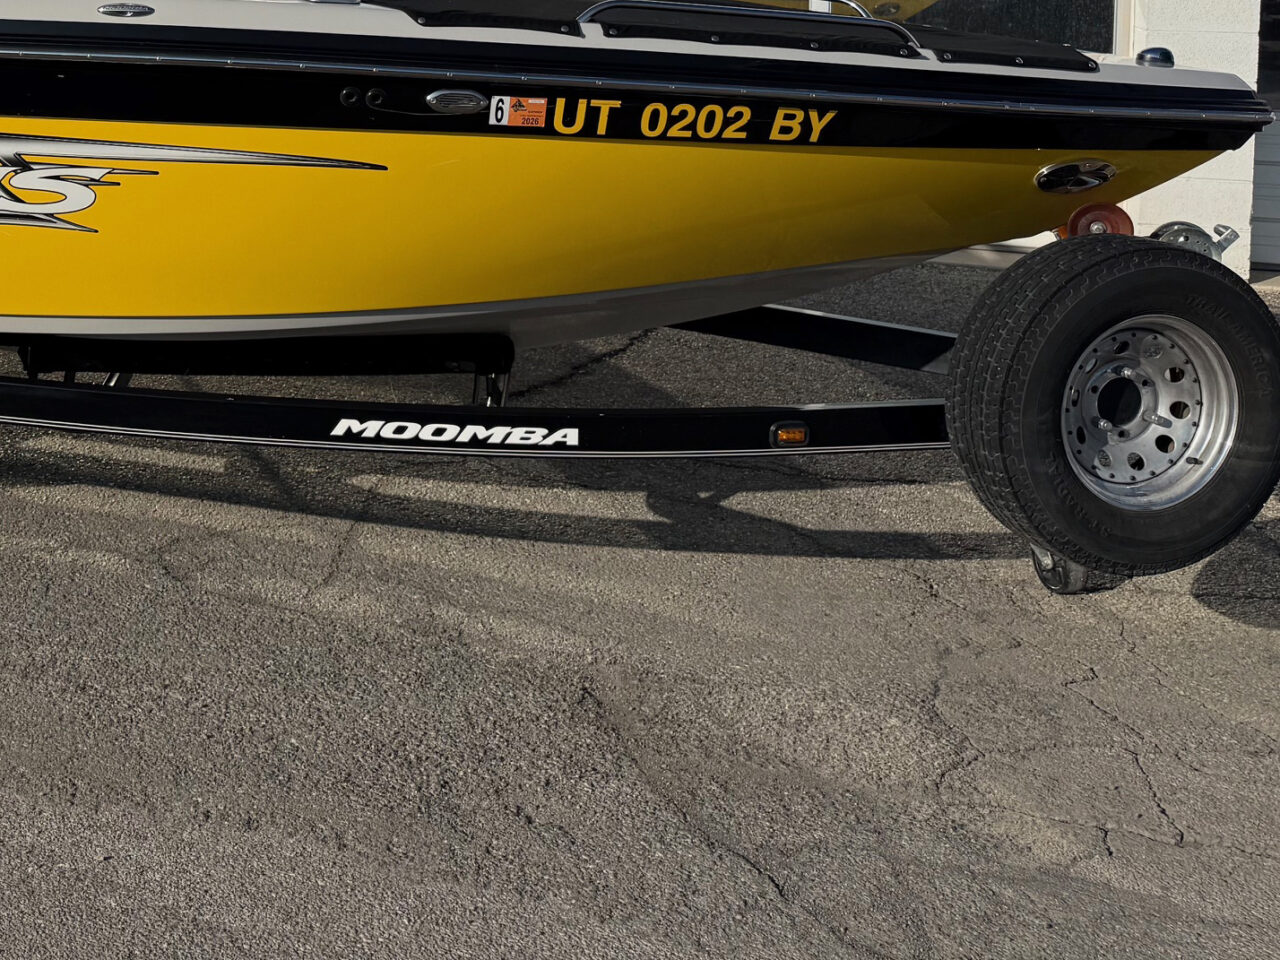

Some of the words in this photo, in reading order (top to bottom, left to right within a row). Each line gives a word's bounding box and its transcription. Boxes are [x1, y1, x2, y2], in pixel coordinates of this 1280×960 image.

[495, 98, 505, 123] 6
[521, 117, 540, 125] 2026
[553, 98, 621, 135] UT
[641, 102, 752, 138] 0202
[769, 106, 838, 142] BY
[330, 419, 579, 446] MOOMBA
